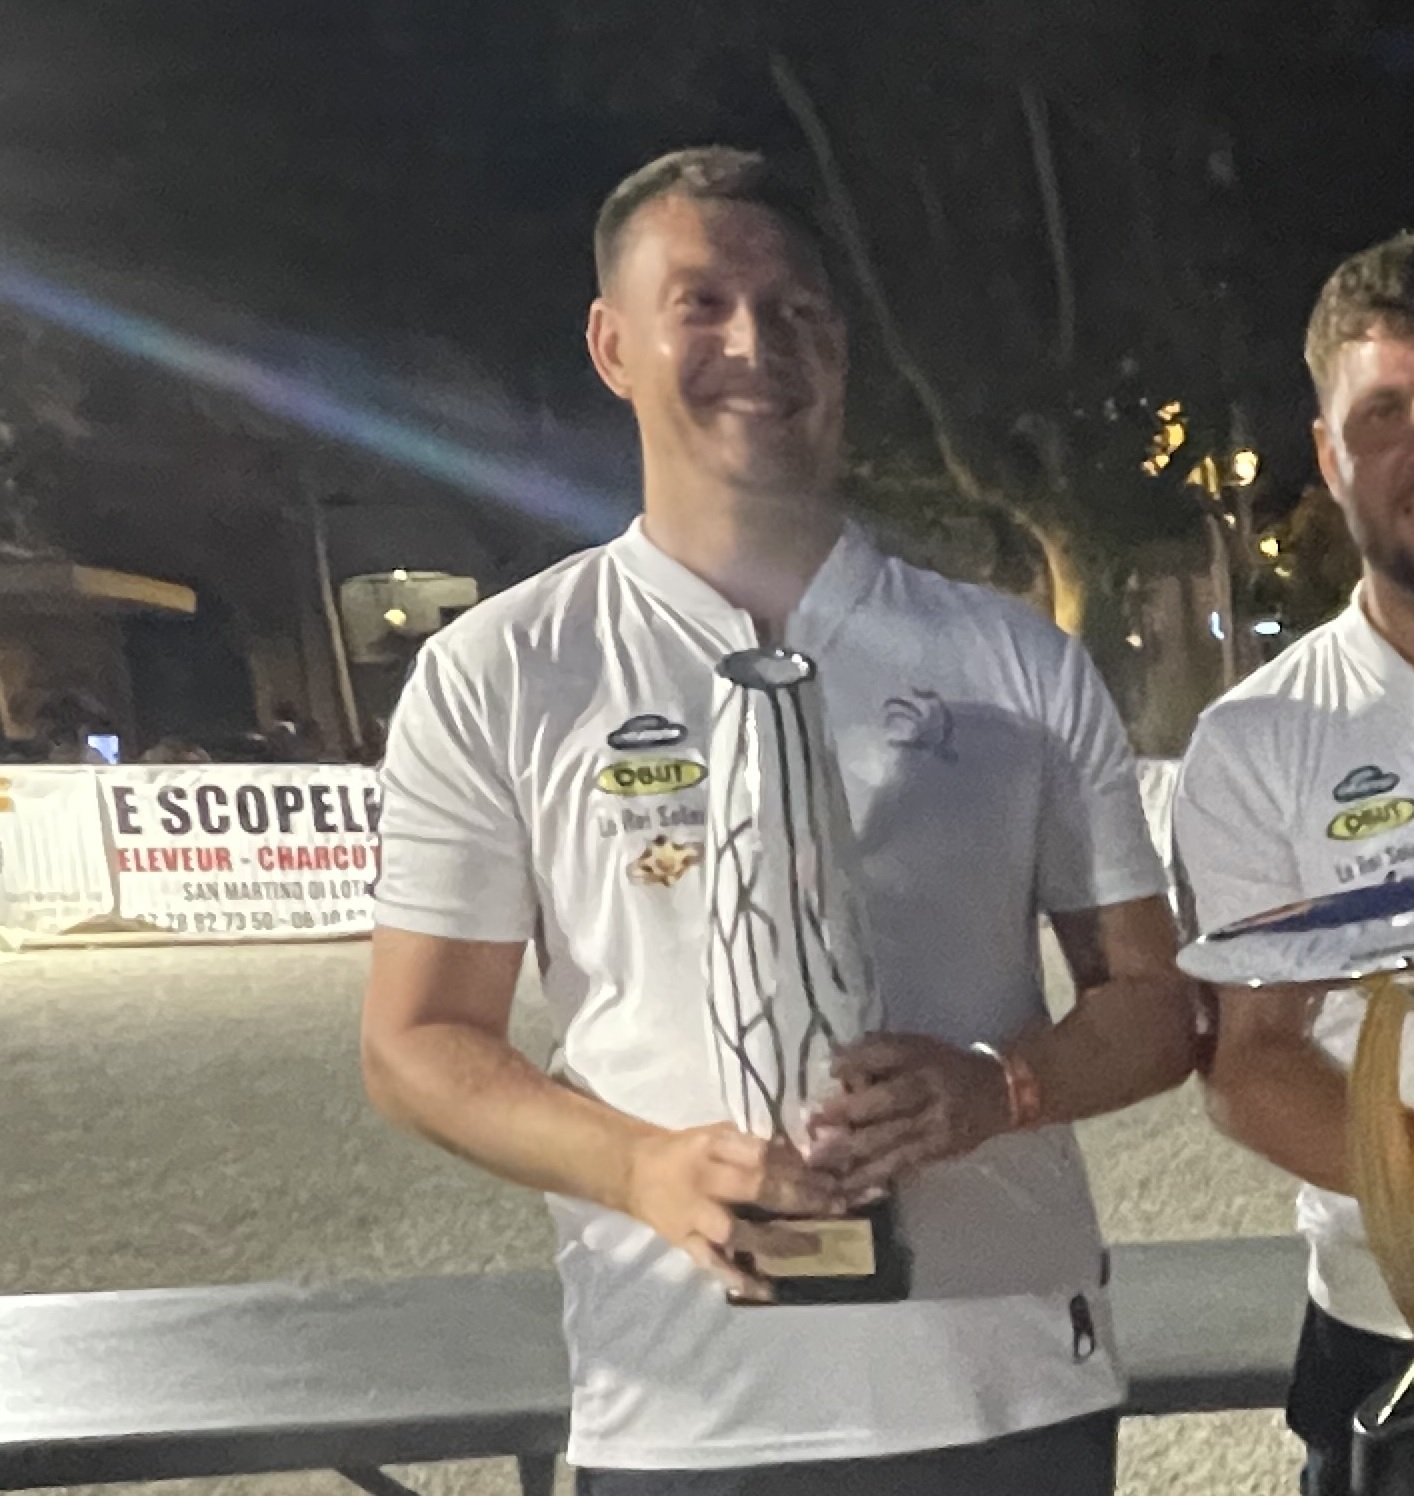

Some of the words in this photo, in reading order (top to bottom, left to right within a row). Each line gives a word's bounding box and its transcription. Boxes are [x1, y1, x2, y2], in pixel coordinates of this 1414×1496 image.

[117, 847, 233, 873] ELEVEUR
[183, 881, 219, 901] SAN
[224, 881, 303, 901] MARTINO
